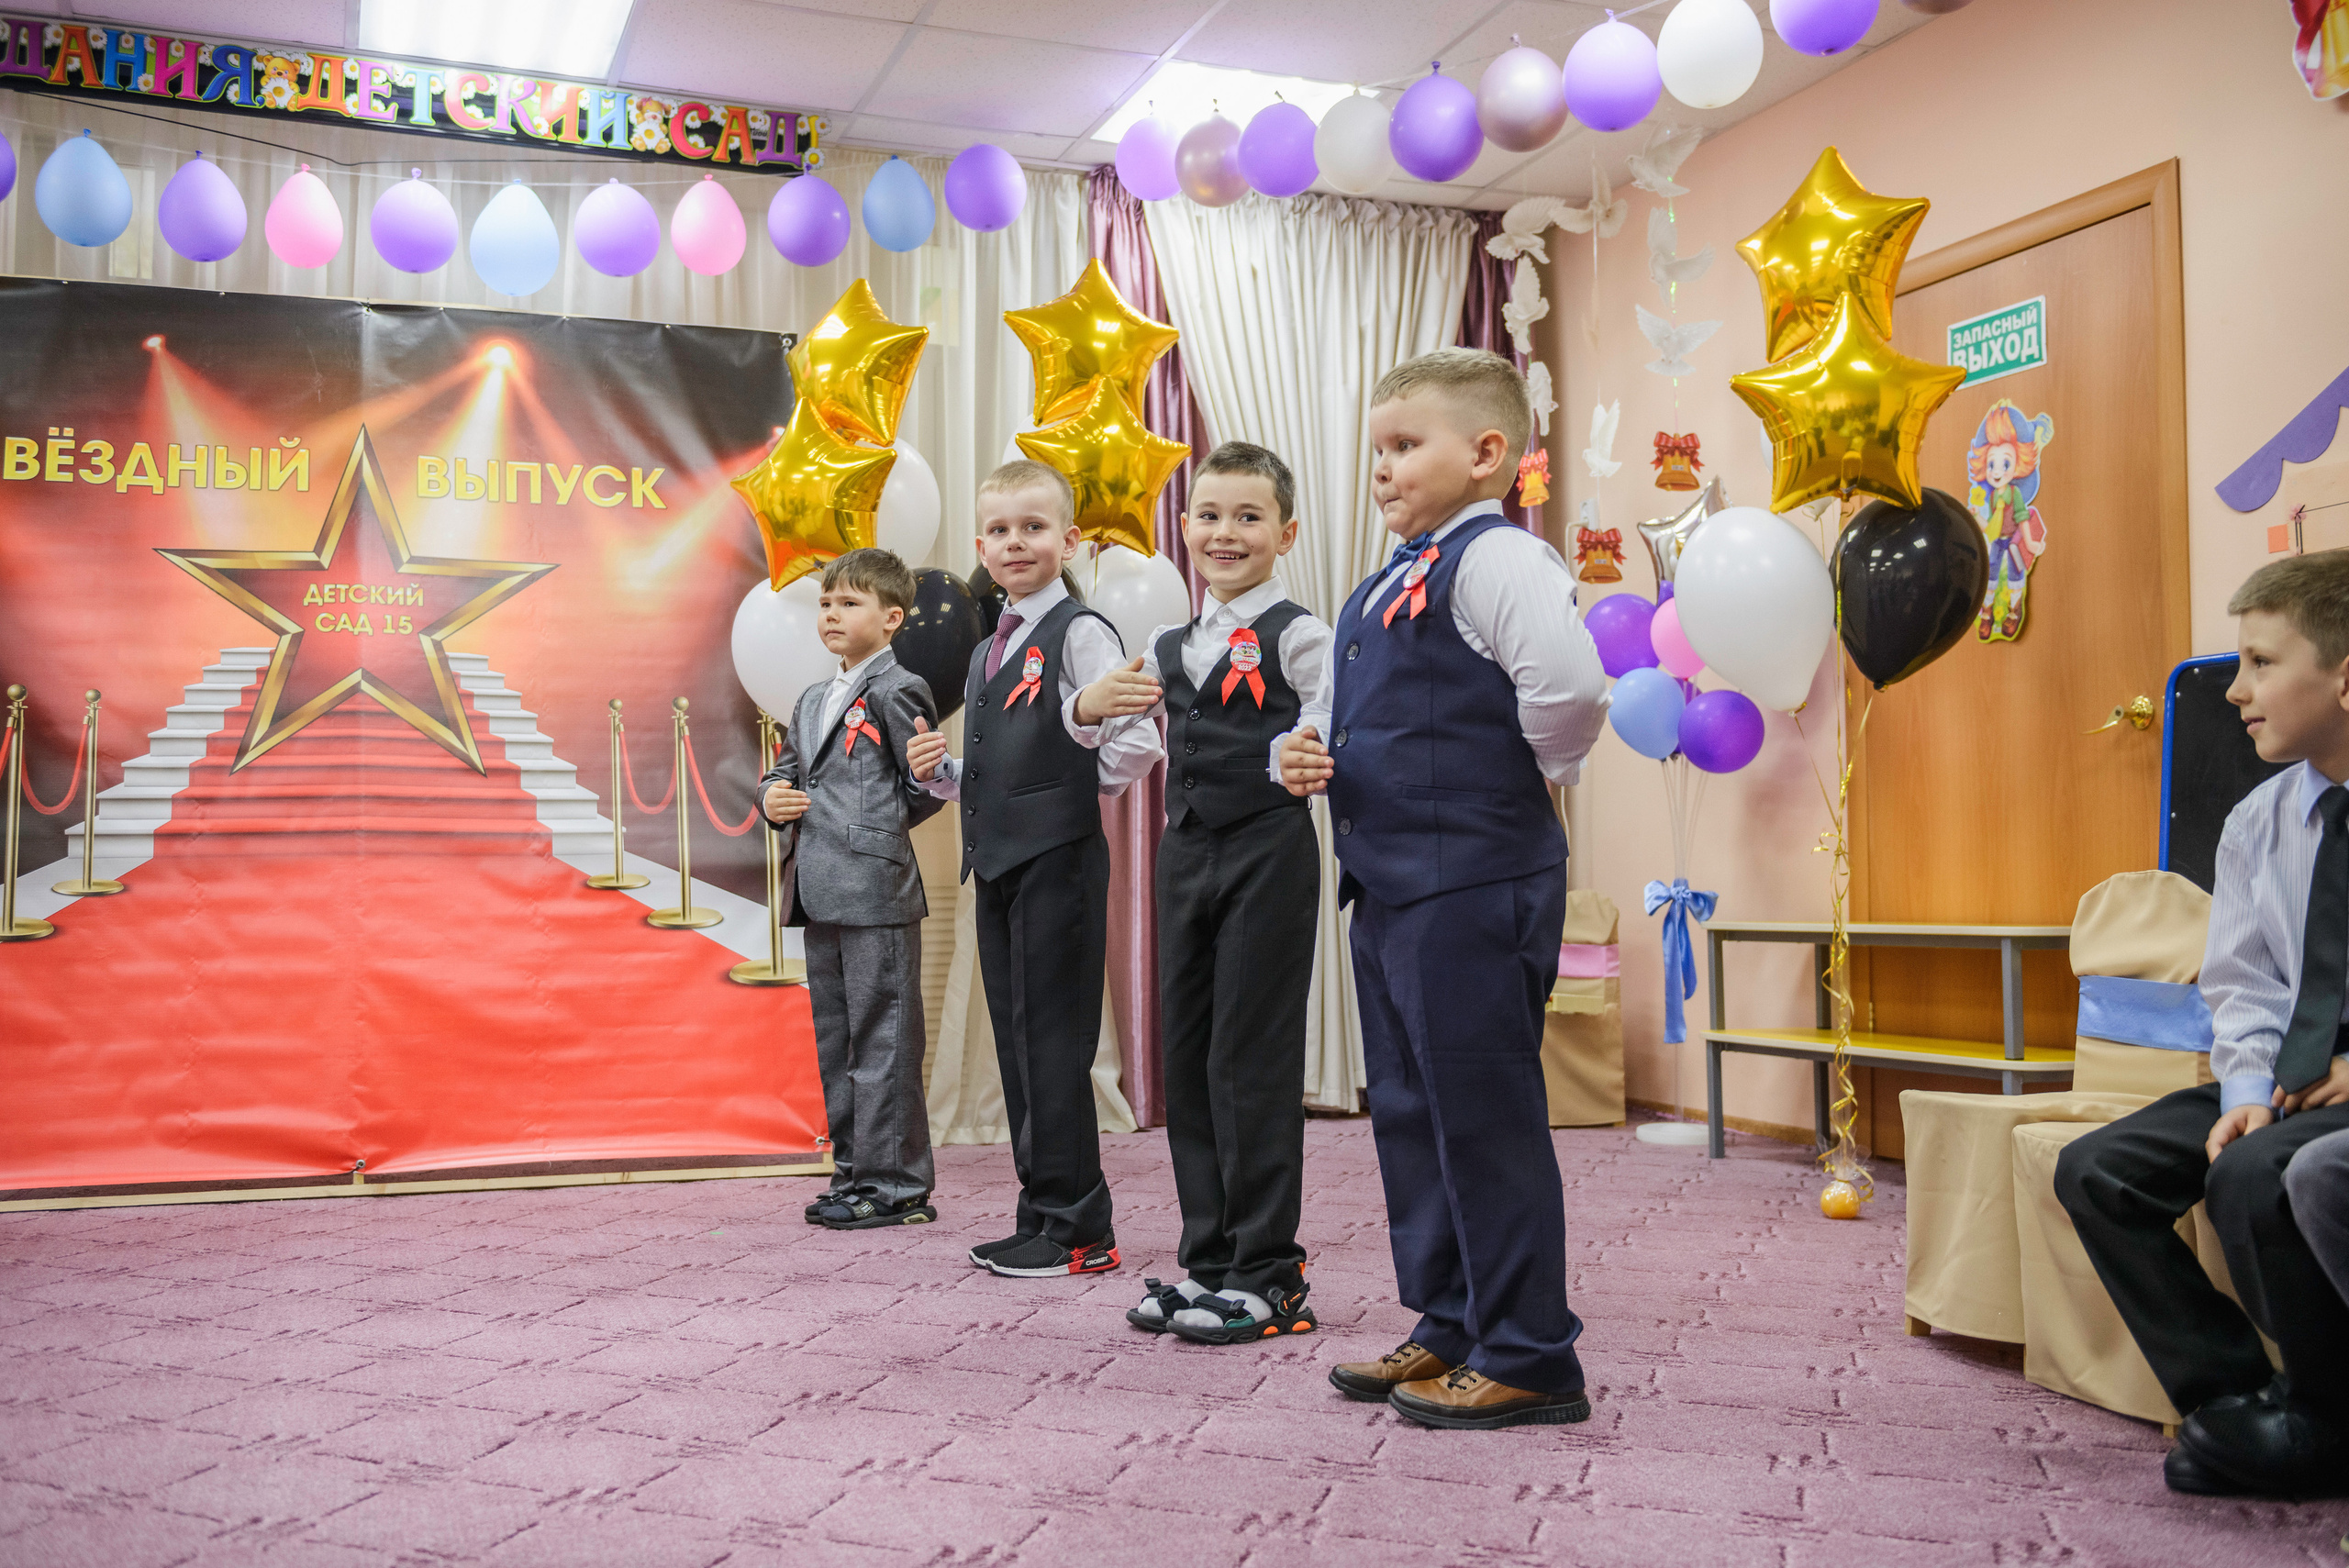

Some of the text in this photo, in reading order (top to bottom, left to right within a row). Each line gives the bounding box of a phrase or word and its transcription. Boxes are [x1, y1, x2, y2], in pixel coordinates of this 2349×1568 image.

[295, 52, 633, 150] ДЕТСКИЙ
[1954, 306, 2037, 349] ЗАПАСНЫЙ
[1953, 326, 2040, 373] ВЫХОД
[3, 427, 667, 509] ВЁЗДНЫЙ ВЫПУСК
[303, 583, 424, 606] ДЕТСКИЙ
[315, 612, 414, 636] САД 15
[1085, 1255, 1108, 1266] CROSBY
